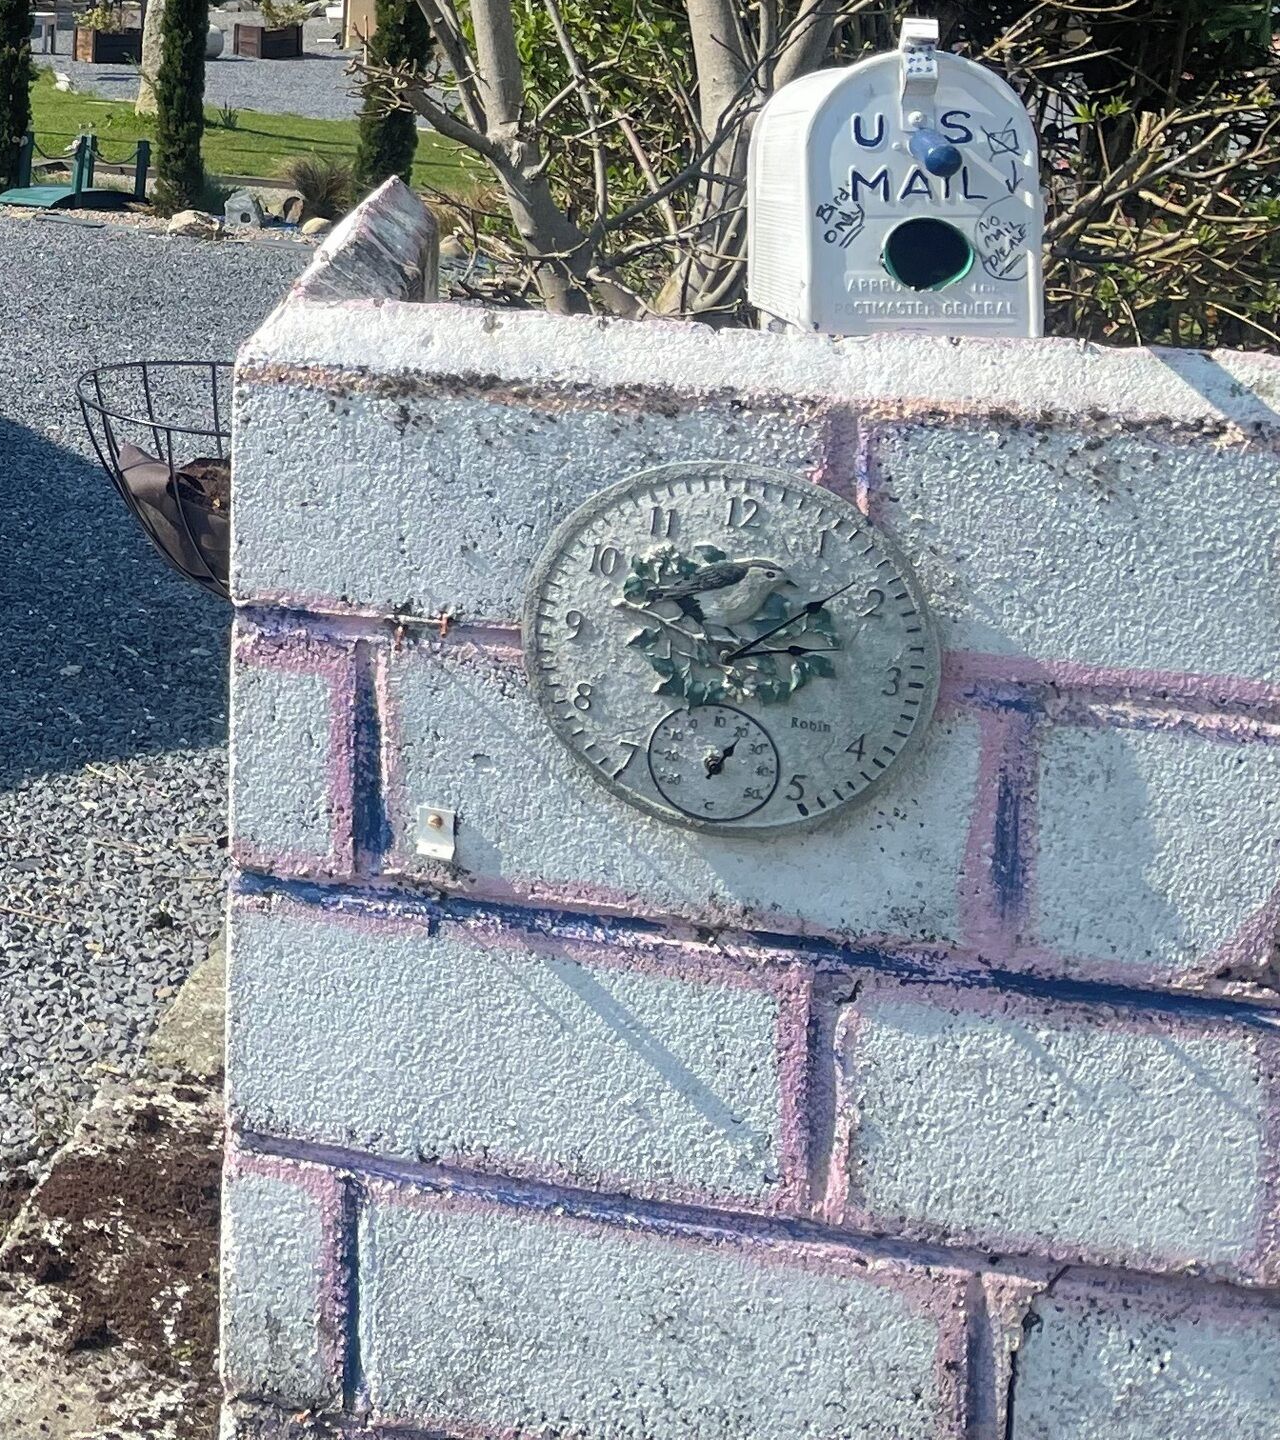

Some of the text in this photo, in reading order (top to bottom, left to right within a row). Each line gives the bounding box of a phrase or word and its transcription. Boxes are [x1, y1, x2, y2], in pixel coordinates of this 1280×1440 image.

[849, 165, 989, 202] MAIL
[979, 216, 1001, 233] NO
[941, 301, 1017, 315] GENERAL
[650, 506, 677, 539] 11
[725, 496, 761, 529] 12
[589, 544, 621, 578] 10
[862, 588, 885, 619] 2
[565, 609, 583, 641] 9
[882, 666, 902, 696] 3
[573, 682, 593, 711] 8
[714, 714, 726, 728] 10
[733, 725, 748, 739] 20
[791, 717, 831, 733] Robin
[618, 739, 641, 771] 7
[845, 733, 867, 762] 4
[785, 773, 808, 802] 5
